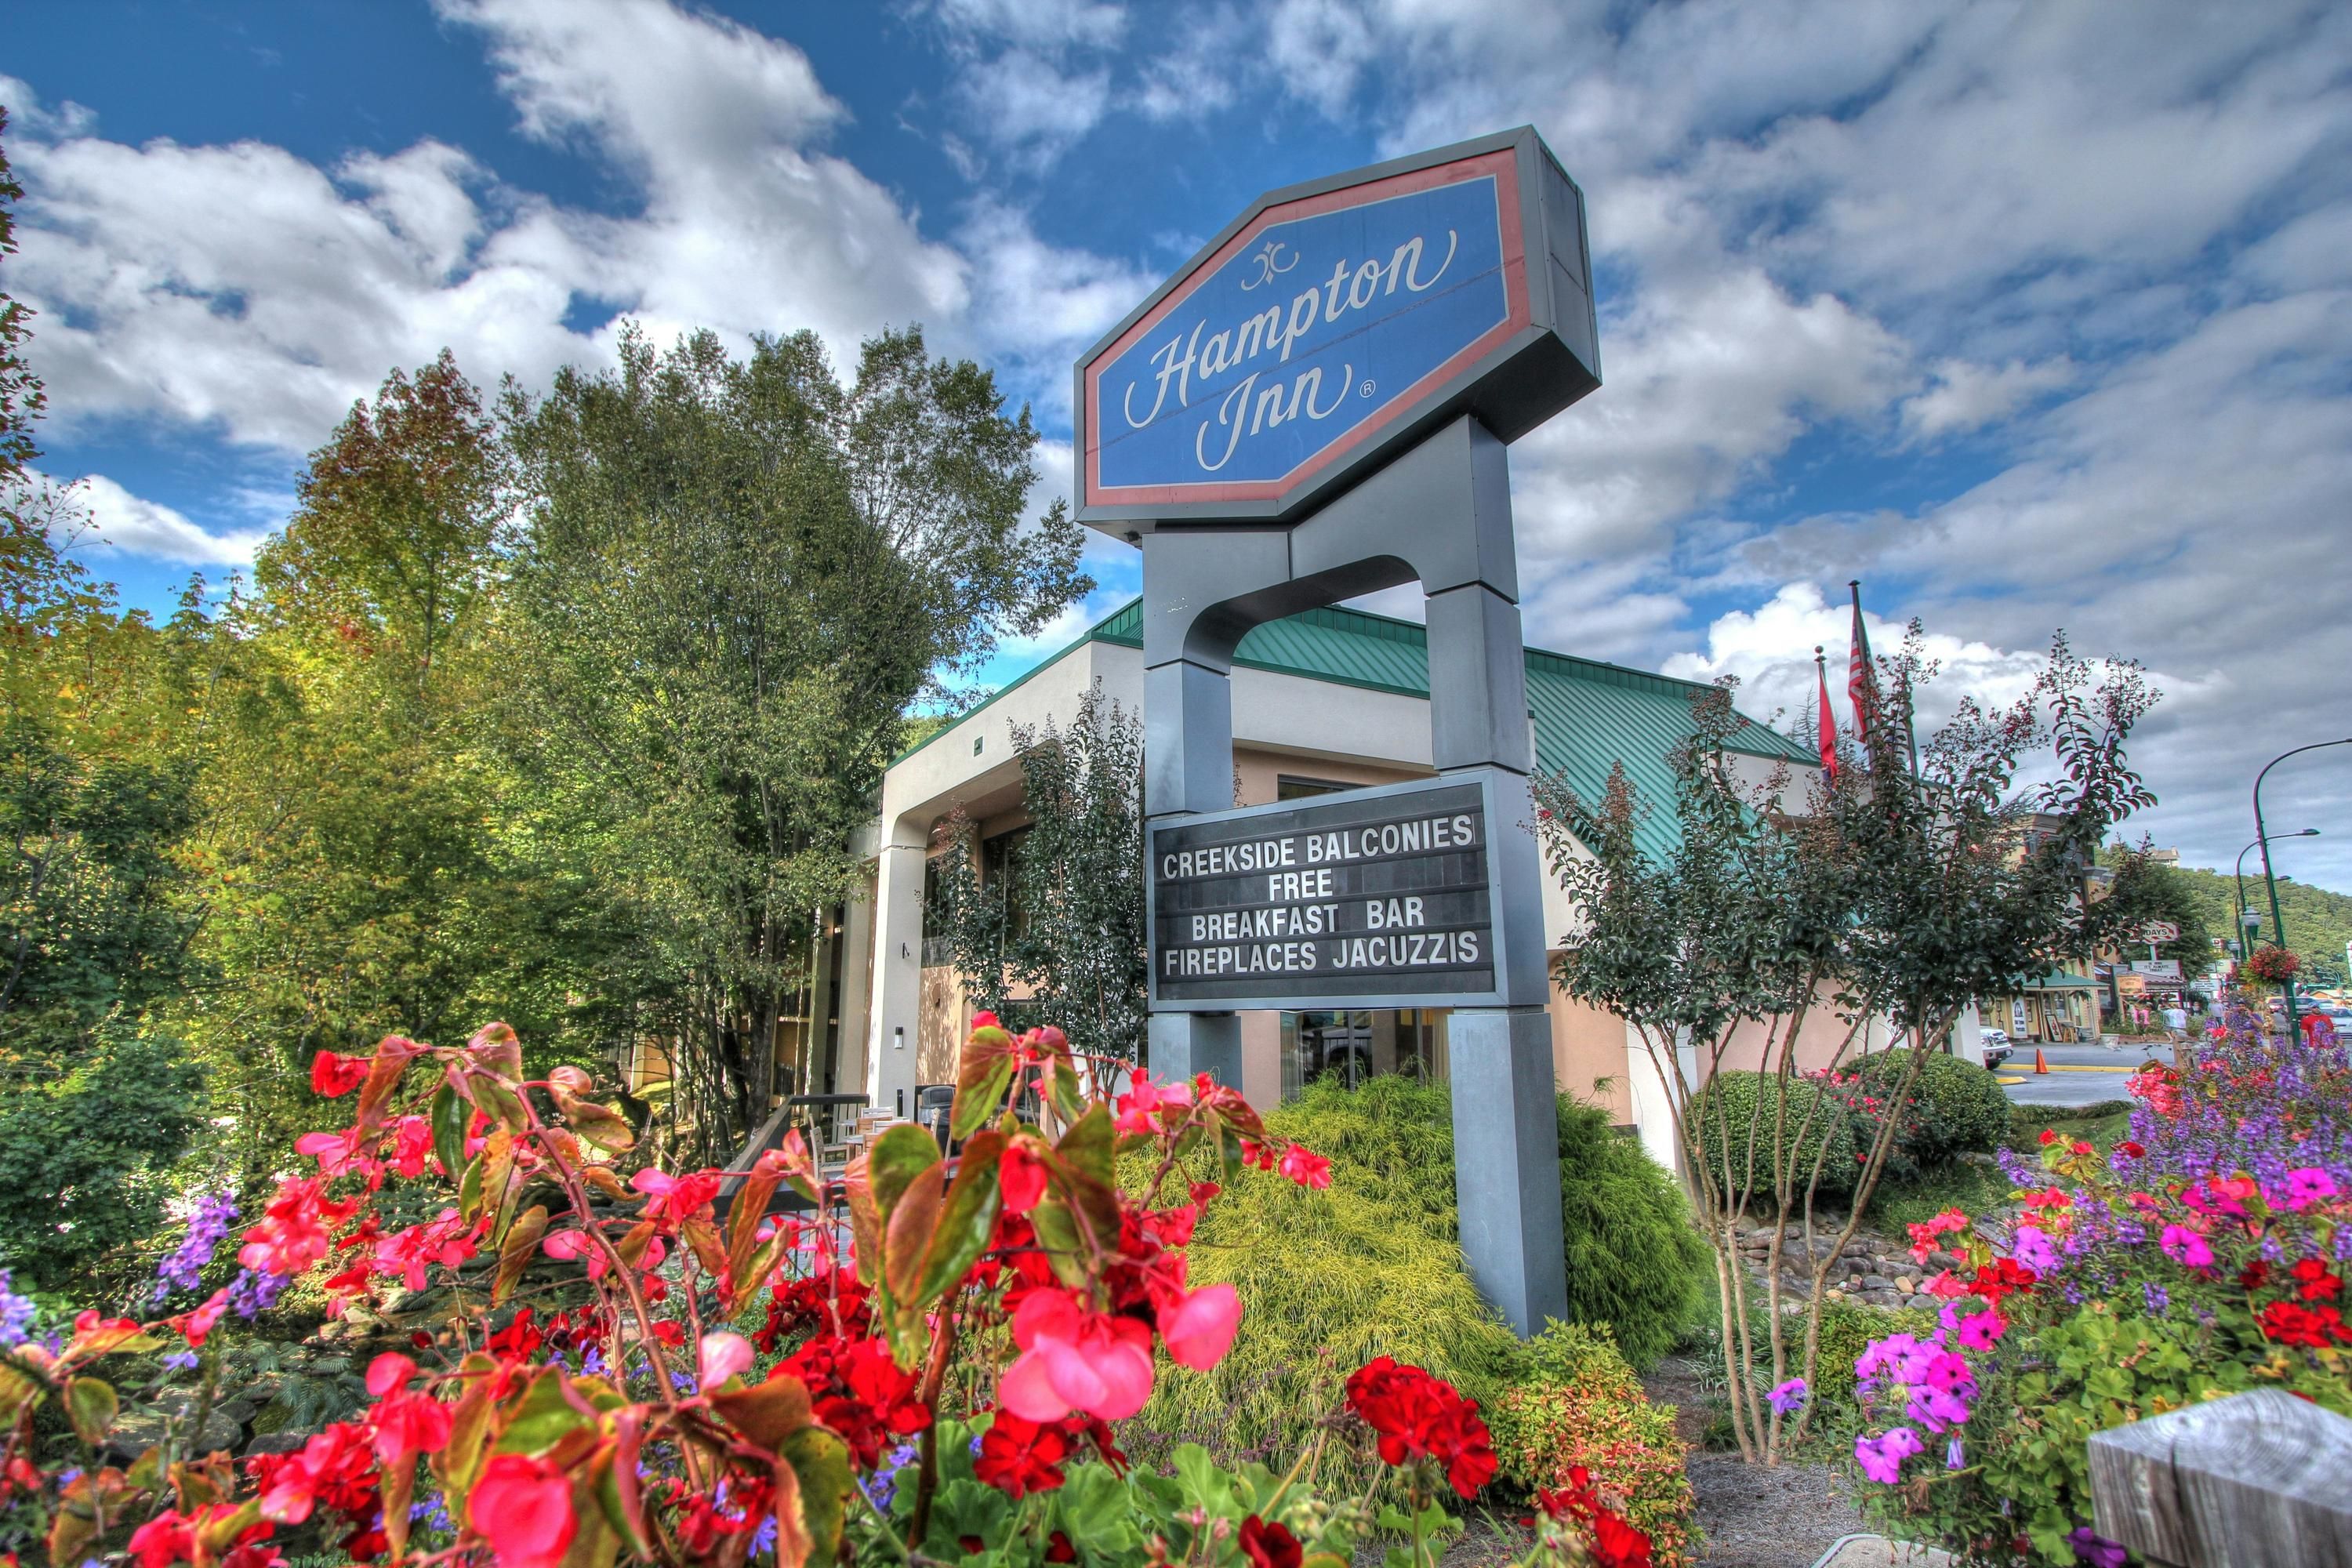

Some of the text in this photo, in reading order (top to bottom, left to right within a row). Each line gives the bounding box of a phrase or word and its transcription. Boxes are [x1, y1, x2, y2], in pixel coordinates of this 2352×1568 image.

[1124, 230, 1457, 428] Hampton
[1196, 363, 1352, 470] Inn
[1163, 815, 1473, 880] CREEKSIDE BALCONIES
[1269, 868, 1333, 902] FREE
[1192, 896, 1425, 941] BREAKFAST BAR
[1165, 931, 1479, 976] FIREPLACES JACUZZIS
